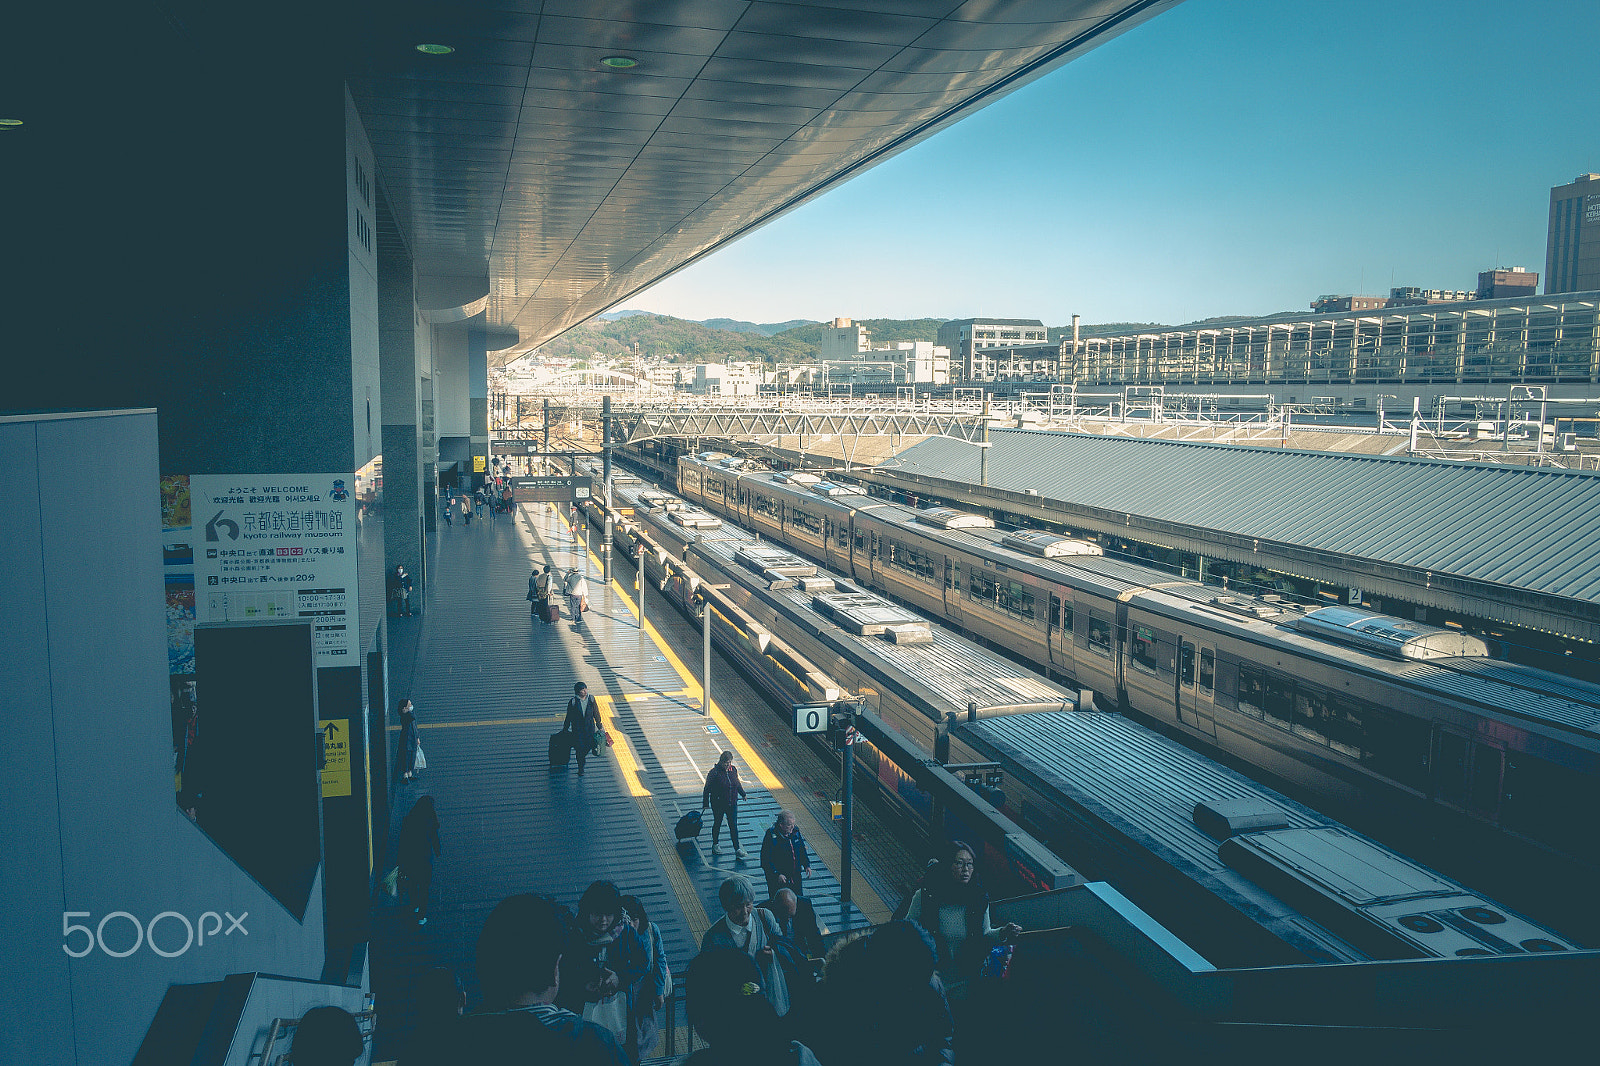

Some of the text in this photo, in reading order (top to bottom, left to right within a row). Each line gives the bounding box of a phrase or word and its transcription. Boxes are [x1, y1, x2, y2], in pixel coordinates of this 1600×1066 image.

[242, 509, 343, 531] 京都鉄道博物館
[243, 532, 268, 540] kyoto
[270, 532, 302, 540] railway
[291, 547, 303, 555] C2
[1351, 588, 1359, 600] 2
[806, 711, 819, 730] 0
